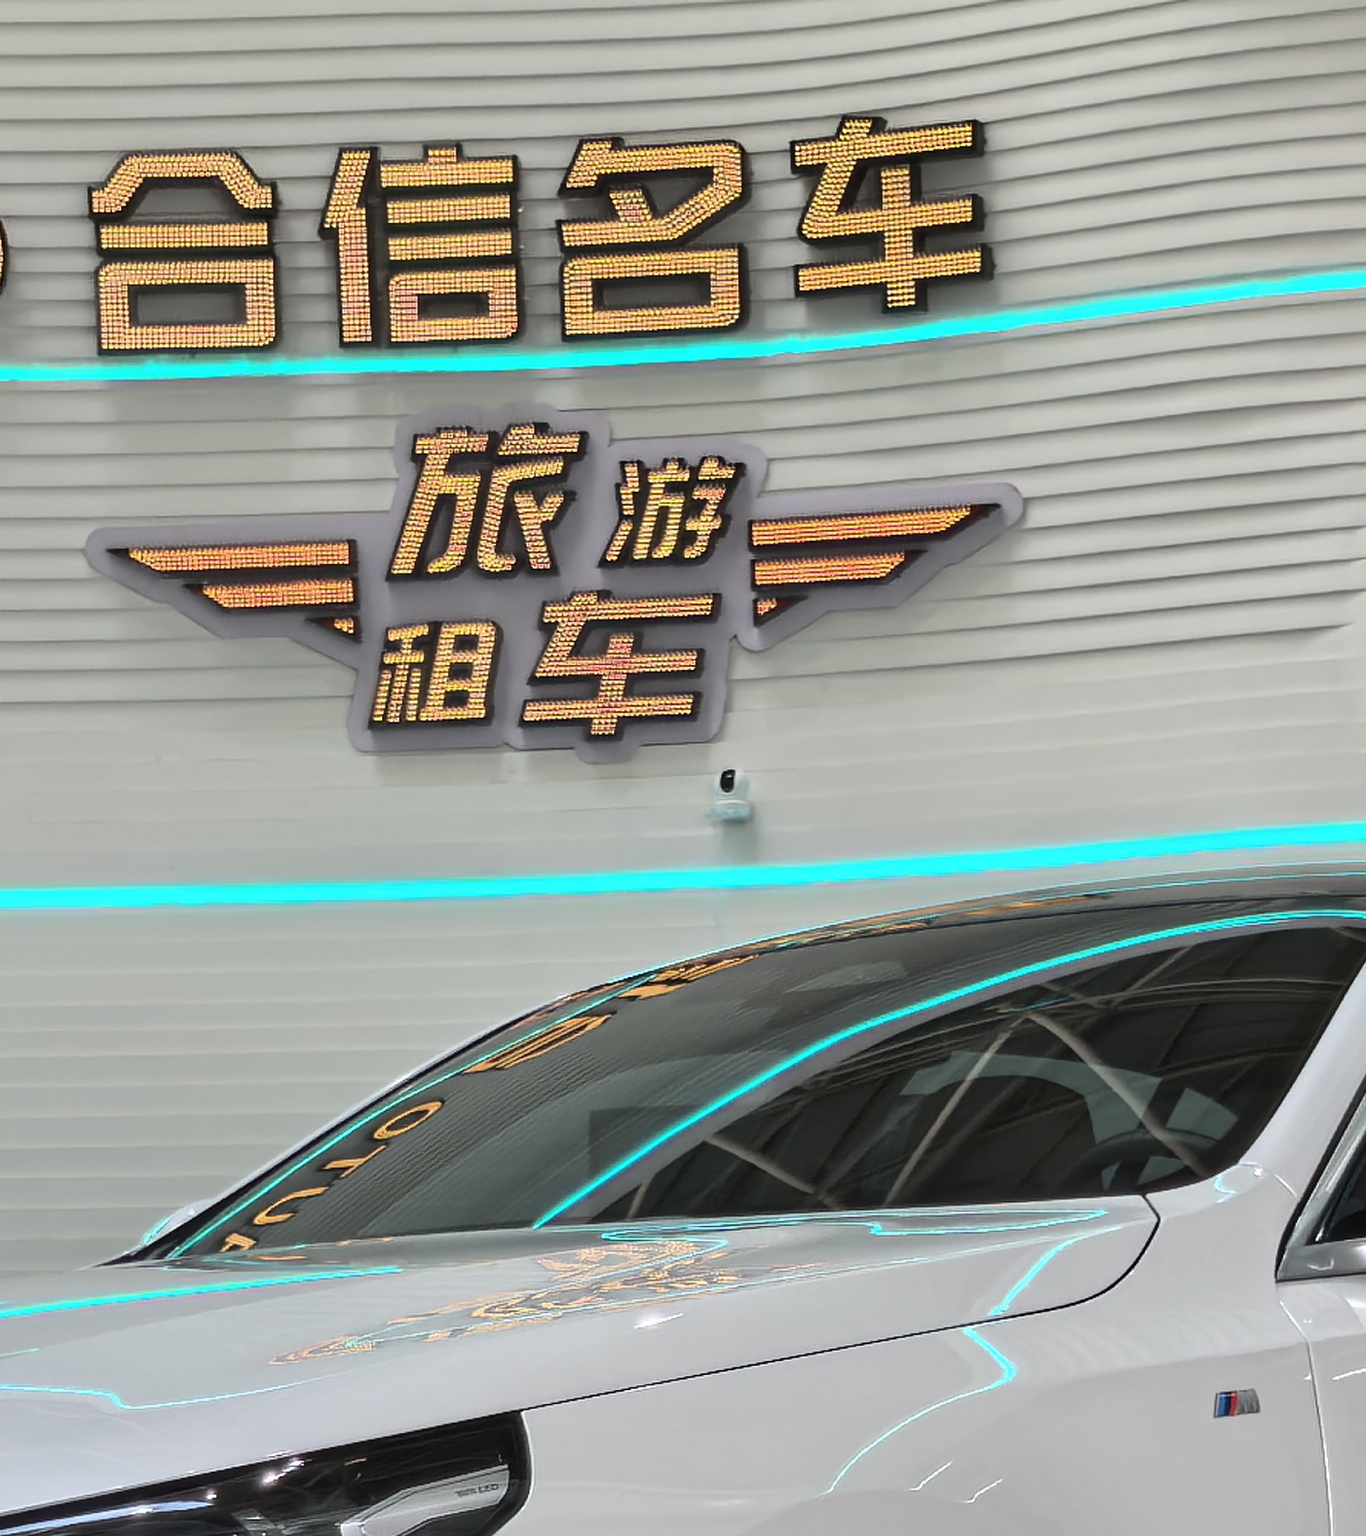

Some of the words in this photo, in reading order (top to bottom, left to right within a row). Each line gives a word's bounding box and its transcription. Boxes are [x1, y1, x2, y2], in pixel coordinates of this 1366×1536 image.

[89, 115, 993, 355] 合信名车
[386, 421, 745, 581] 旅游
[368, 590, 722, 742] 租车
